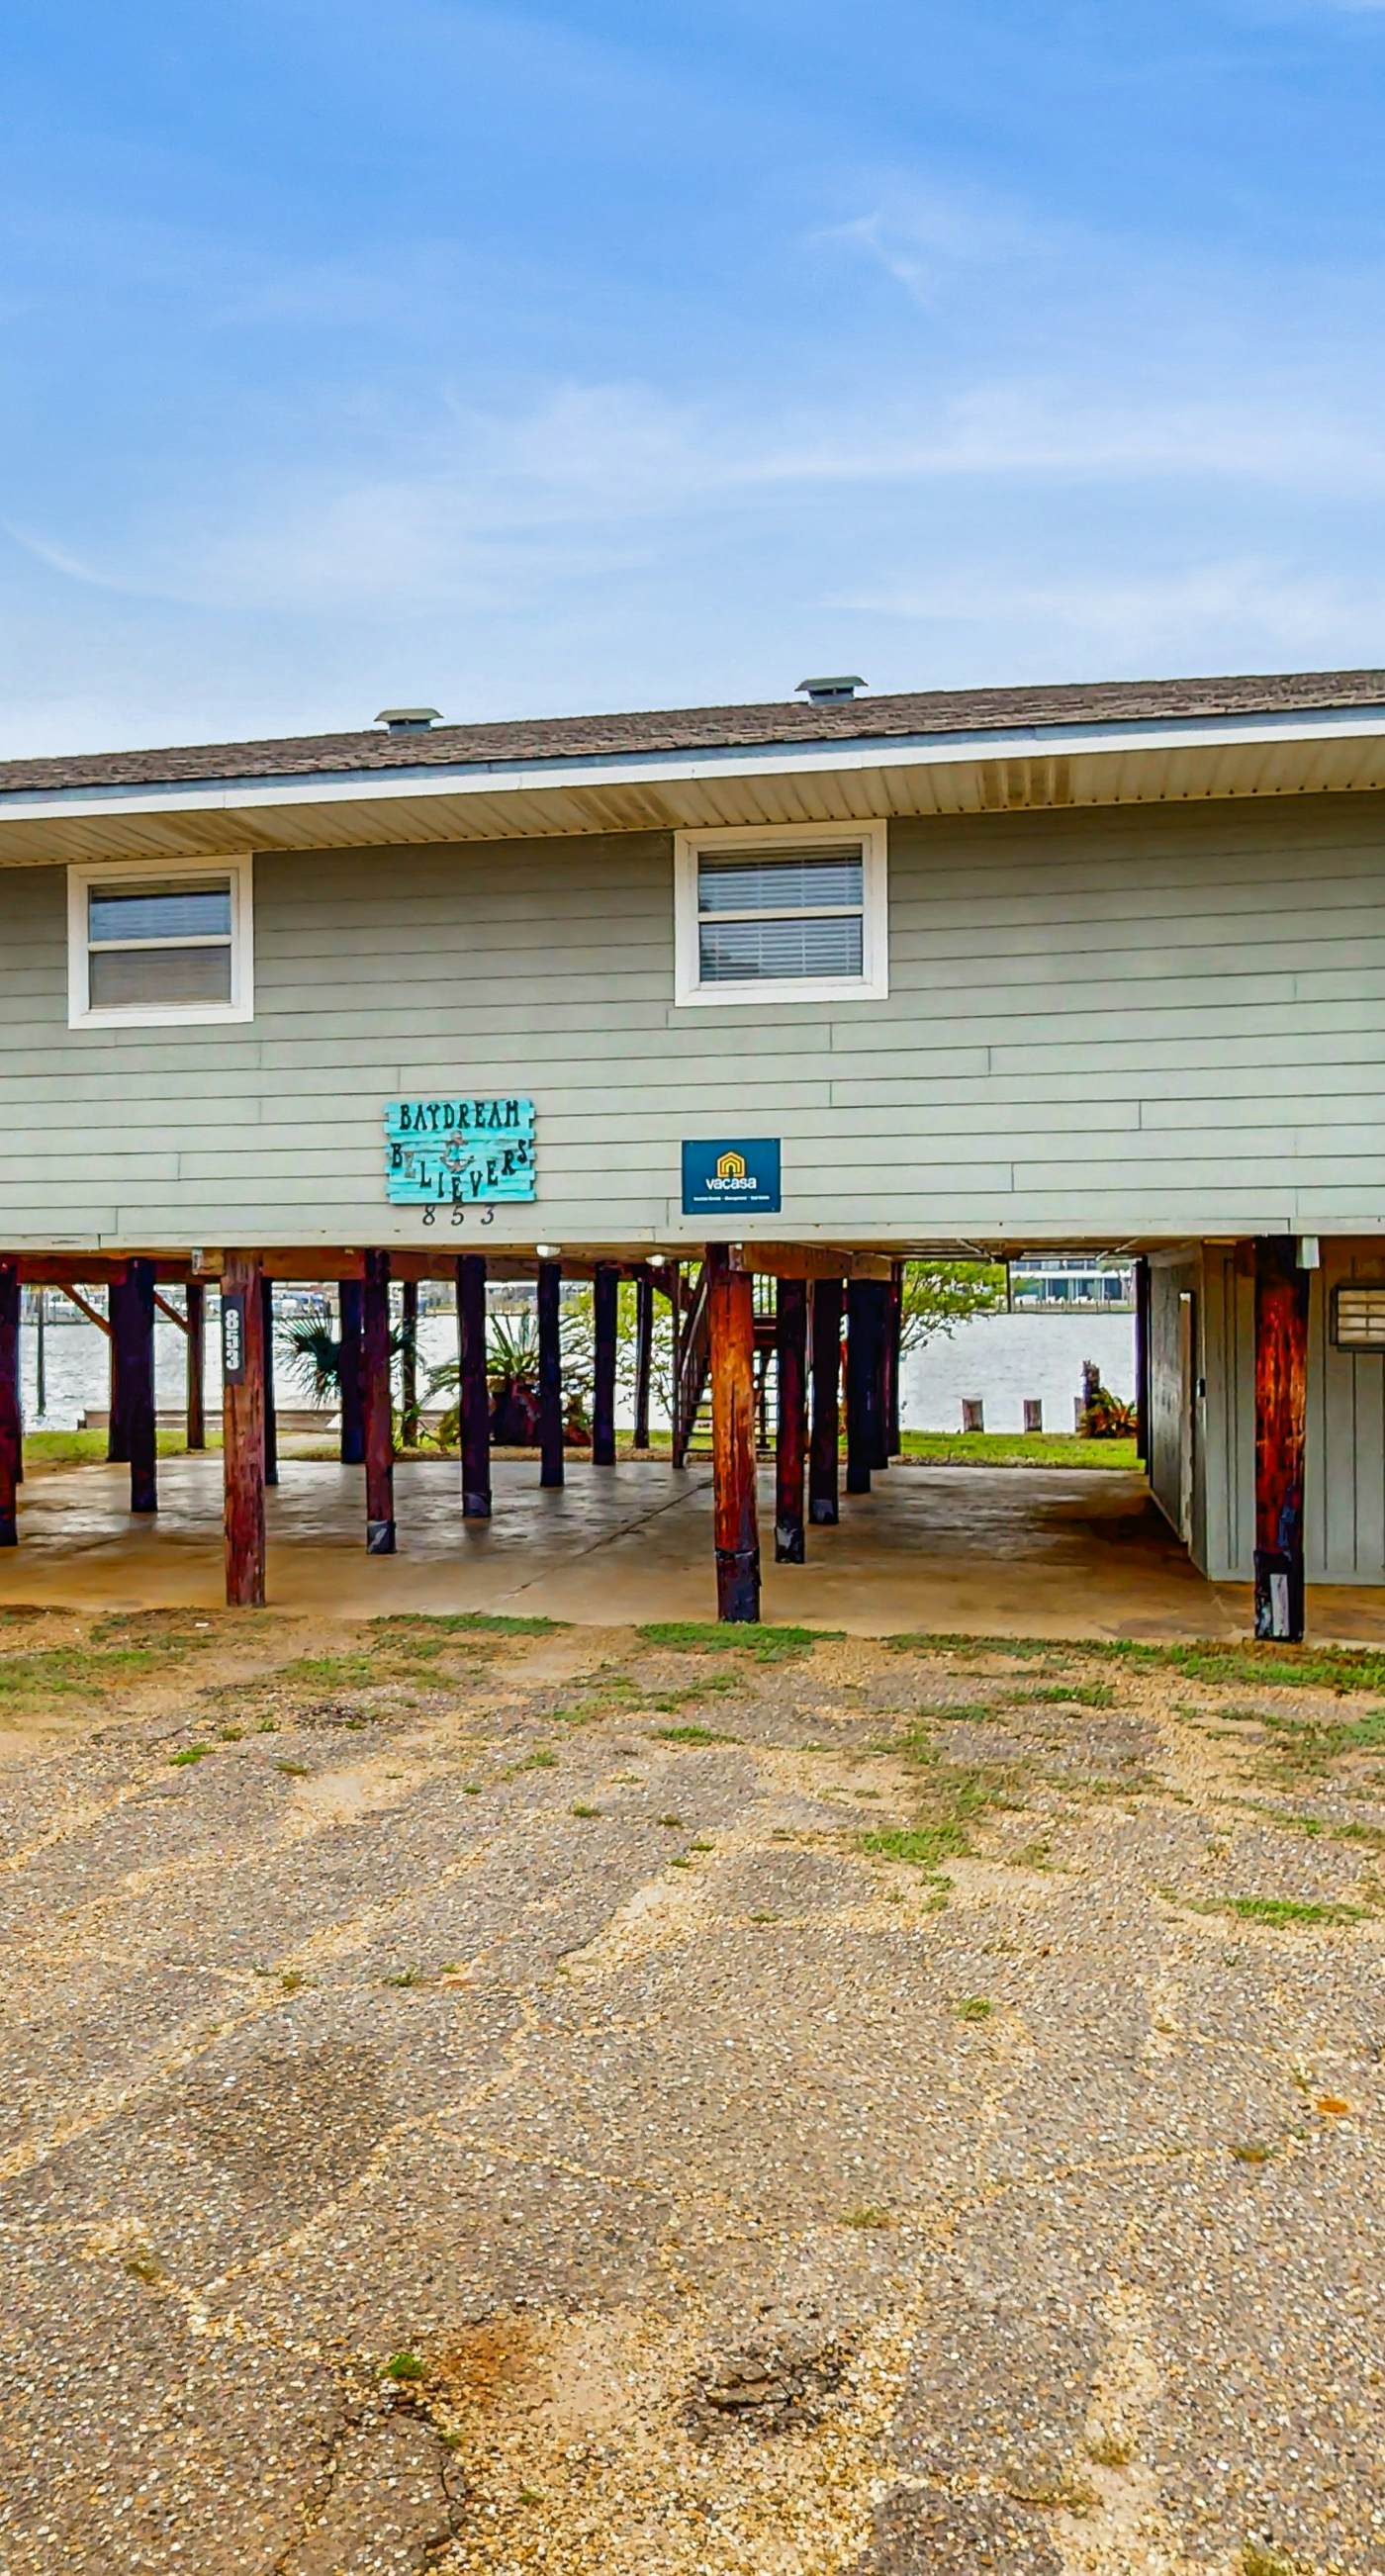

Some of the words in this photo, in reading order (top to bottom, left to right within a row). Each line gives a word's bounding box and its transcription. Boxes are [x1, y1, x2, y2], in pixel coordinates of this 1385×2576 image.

[399, 1099, 520, 1131] BAYDREAM
[705, 1176, 757, 1190] vacasa
[421, 1203, 497, 1227] 853
[225, 1308, 239, 1371] 853
